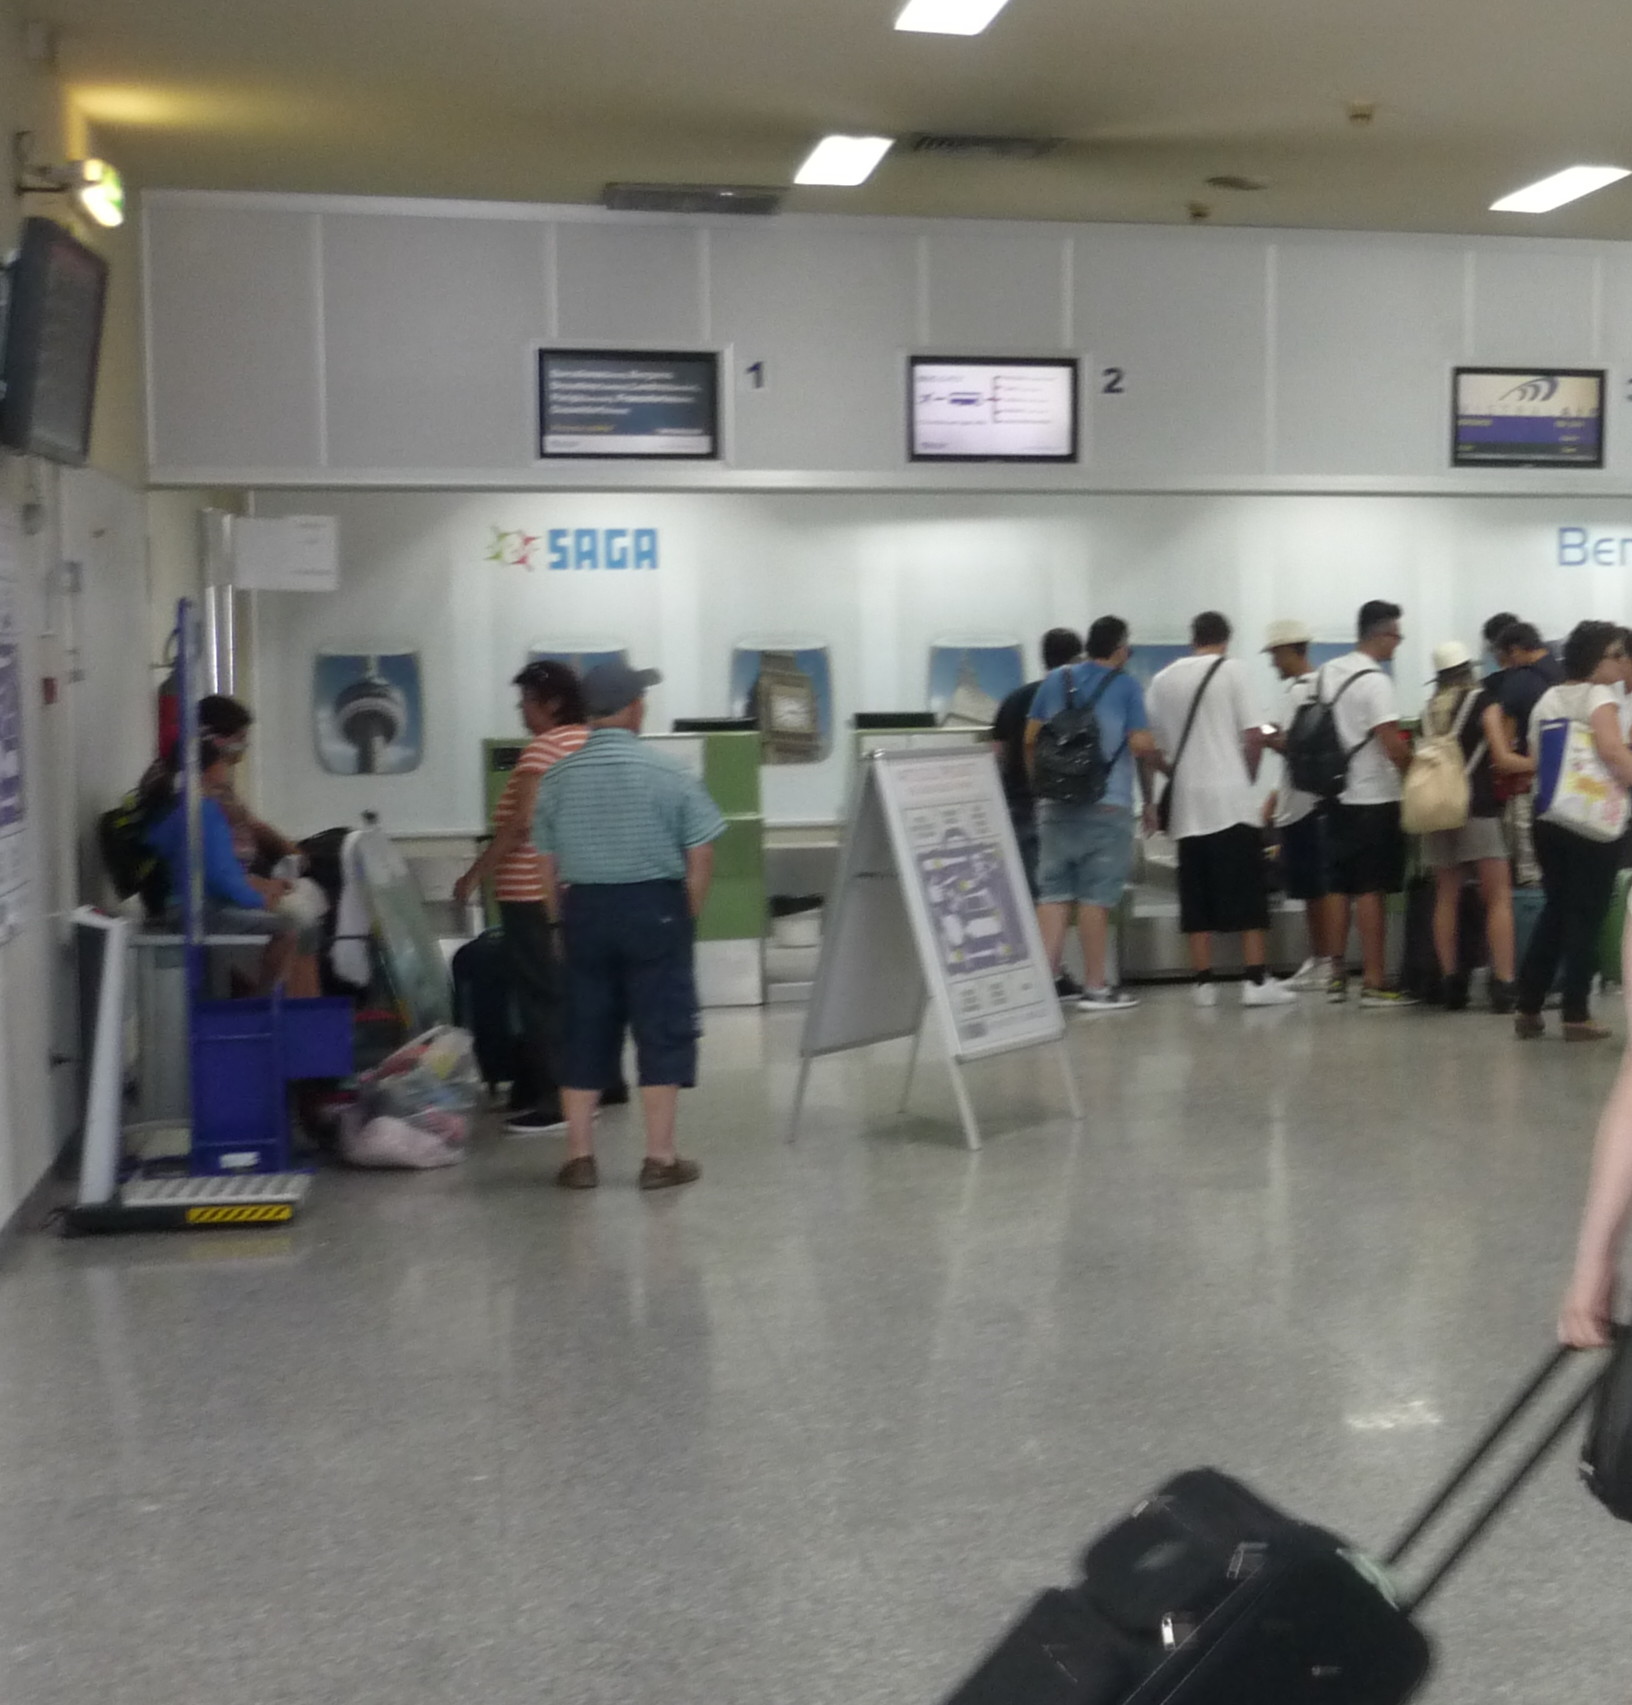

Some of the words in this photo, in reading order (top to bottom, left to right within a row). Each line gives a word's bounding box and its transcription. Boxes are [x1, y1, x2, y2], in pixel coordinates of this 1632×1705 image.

[746, 361, 765, 388] 1
[1102, 367, 1124, 394] 2
[547, 527, 659, 570] SAGA
